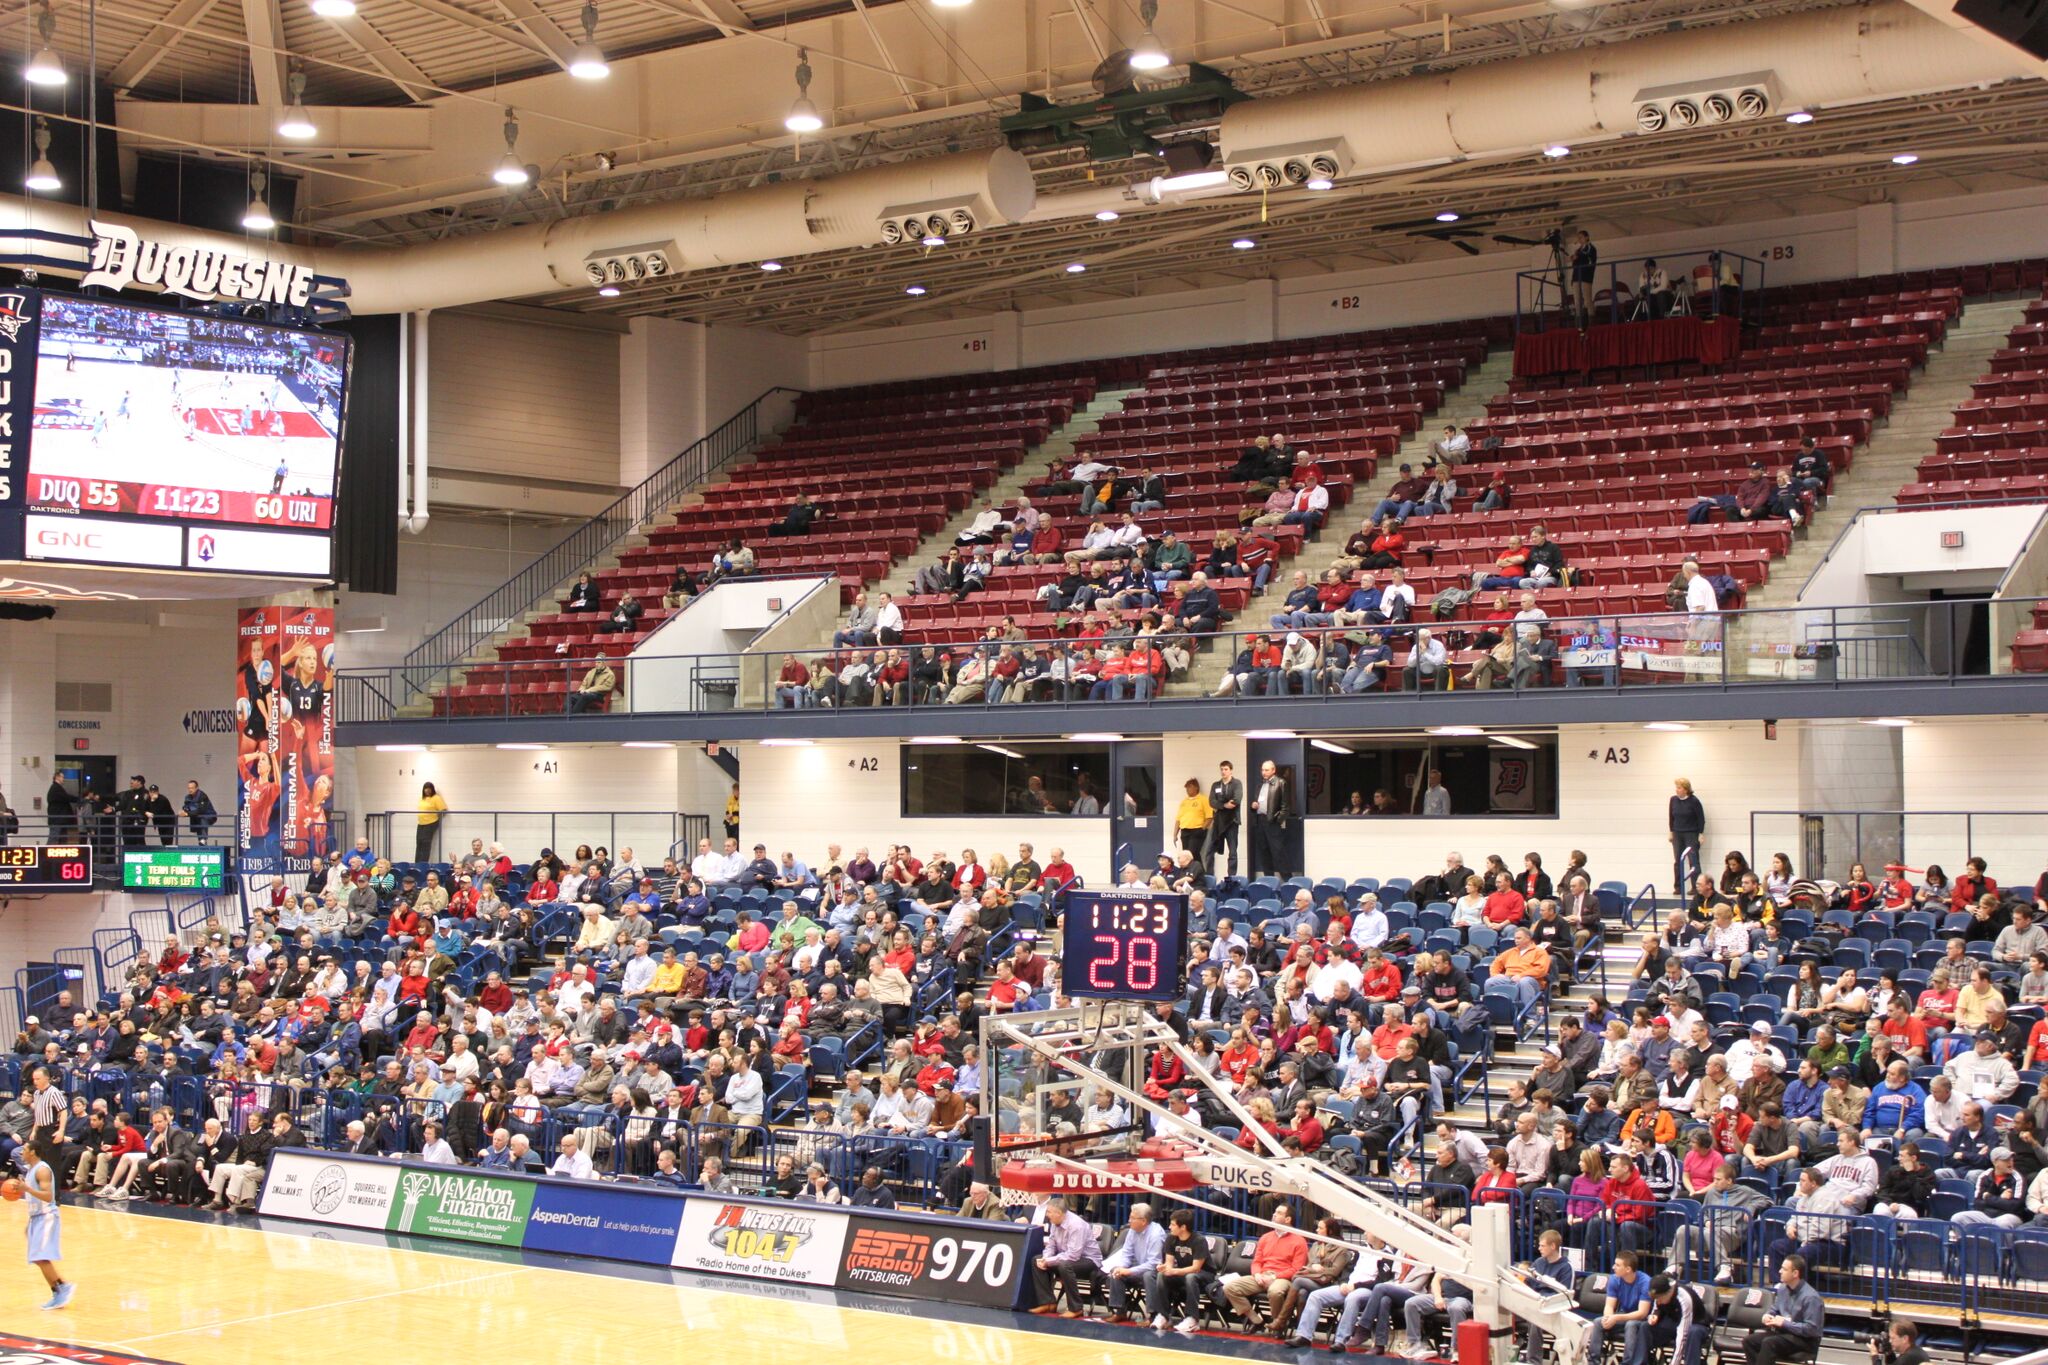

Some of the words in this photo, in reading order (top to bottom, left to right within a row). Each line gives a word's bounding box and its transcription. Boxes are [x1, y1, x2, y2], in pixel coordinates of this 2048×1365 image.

[1773, 245, 1794, 260] B3
[80, 219, 314, 308] DUQUESNE
[1342, 296, 1360, 309] B2
[973, 339, 986, 351] B1
[39, 479, 81, 508] DUQ
[87, 482, 118, 506] 55
[154, 488, 220, 515] 11:23
[255, 497, 283, 519] 60
[288, 500, 317, 523] URI
[30, 506, 80, 515] DAKTRONICS
[38, 530, 103, 549] GNC
[241, 626, 262, 635] RISE
[264, 625, 277, 634] UP
[285, 625, 311, 635] RISE
[315, 627, 330, 635] UP
[300, 697, 312, 709] 13
[58, 720, 101, 729] CONCESSIONS
[191, 710, 239, 733] CONCESSI
[272, 688, 280, 753] WRIGHT
[1605, 747, 1630, 764] A3
[543, 761, 558, 774] A1
[860, 757, 879, 771] A2
[289, 752, 297, 849] SCHEIRMAN
[47, 848, 79, 857] RAMS
[14, 869, 23, 881] 2
[62, 863, 84, 879] 60
[148, 866, 169, 874] TEAM
[171, 866, 196, 875] FOULS
[1093, 903, 1168, 933] 11:23
[1089, 936, 1157, 989] 28
[1211, 1165, 1273, 1188] DUKES
[272, 1185, 296, 1196] SMALLMAN
[354, 1182, 376, 1193] SQUIRREL
[377, 1184, 387, 1194] HILL
[429, 1175, 513, 1206] McMahon
[358, 1196, 377, 1207] MURRAY
[437, 1192, 516, 1222] Financial
[604, 1221, 612, 1229] Let
[619, 1221, 629, 1231] help
[640, 1224, 649, 1233] find
[649, 1227, 661, 1235] your
[725, 1229, 800, 1264] 104.7
[851, 1229, 931, 1261] ESPN
[725, 1260, 750, 1272] Home
[752, 1264, 762, 1273] of
[764, 1265, 777, 1275] the
[854, 1256, 914, 1273] RADIO
[929, 1237, 1013, 1287] 970
[849, 1268, 912, 1287] PITTSBURGH
